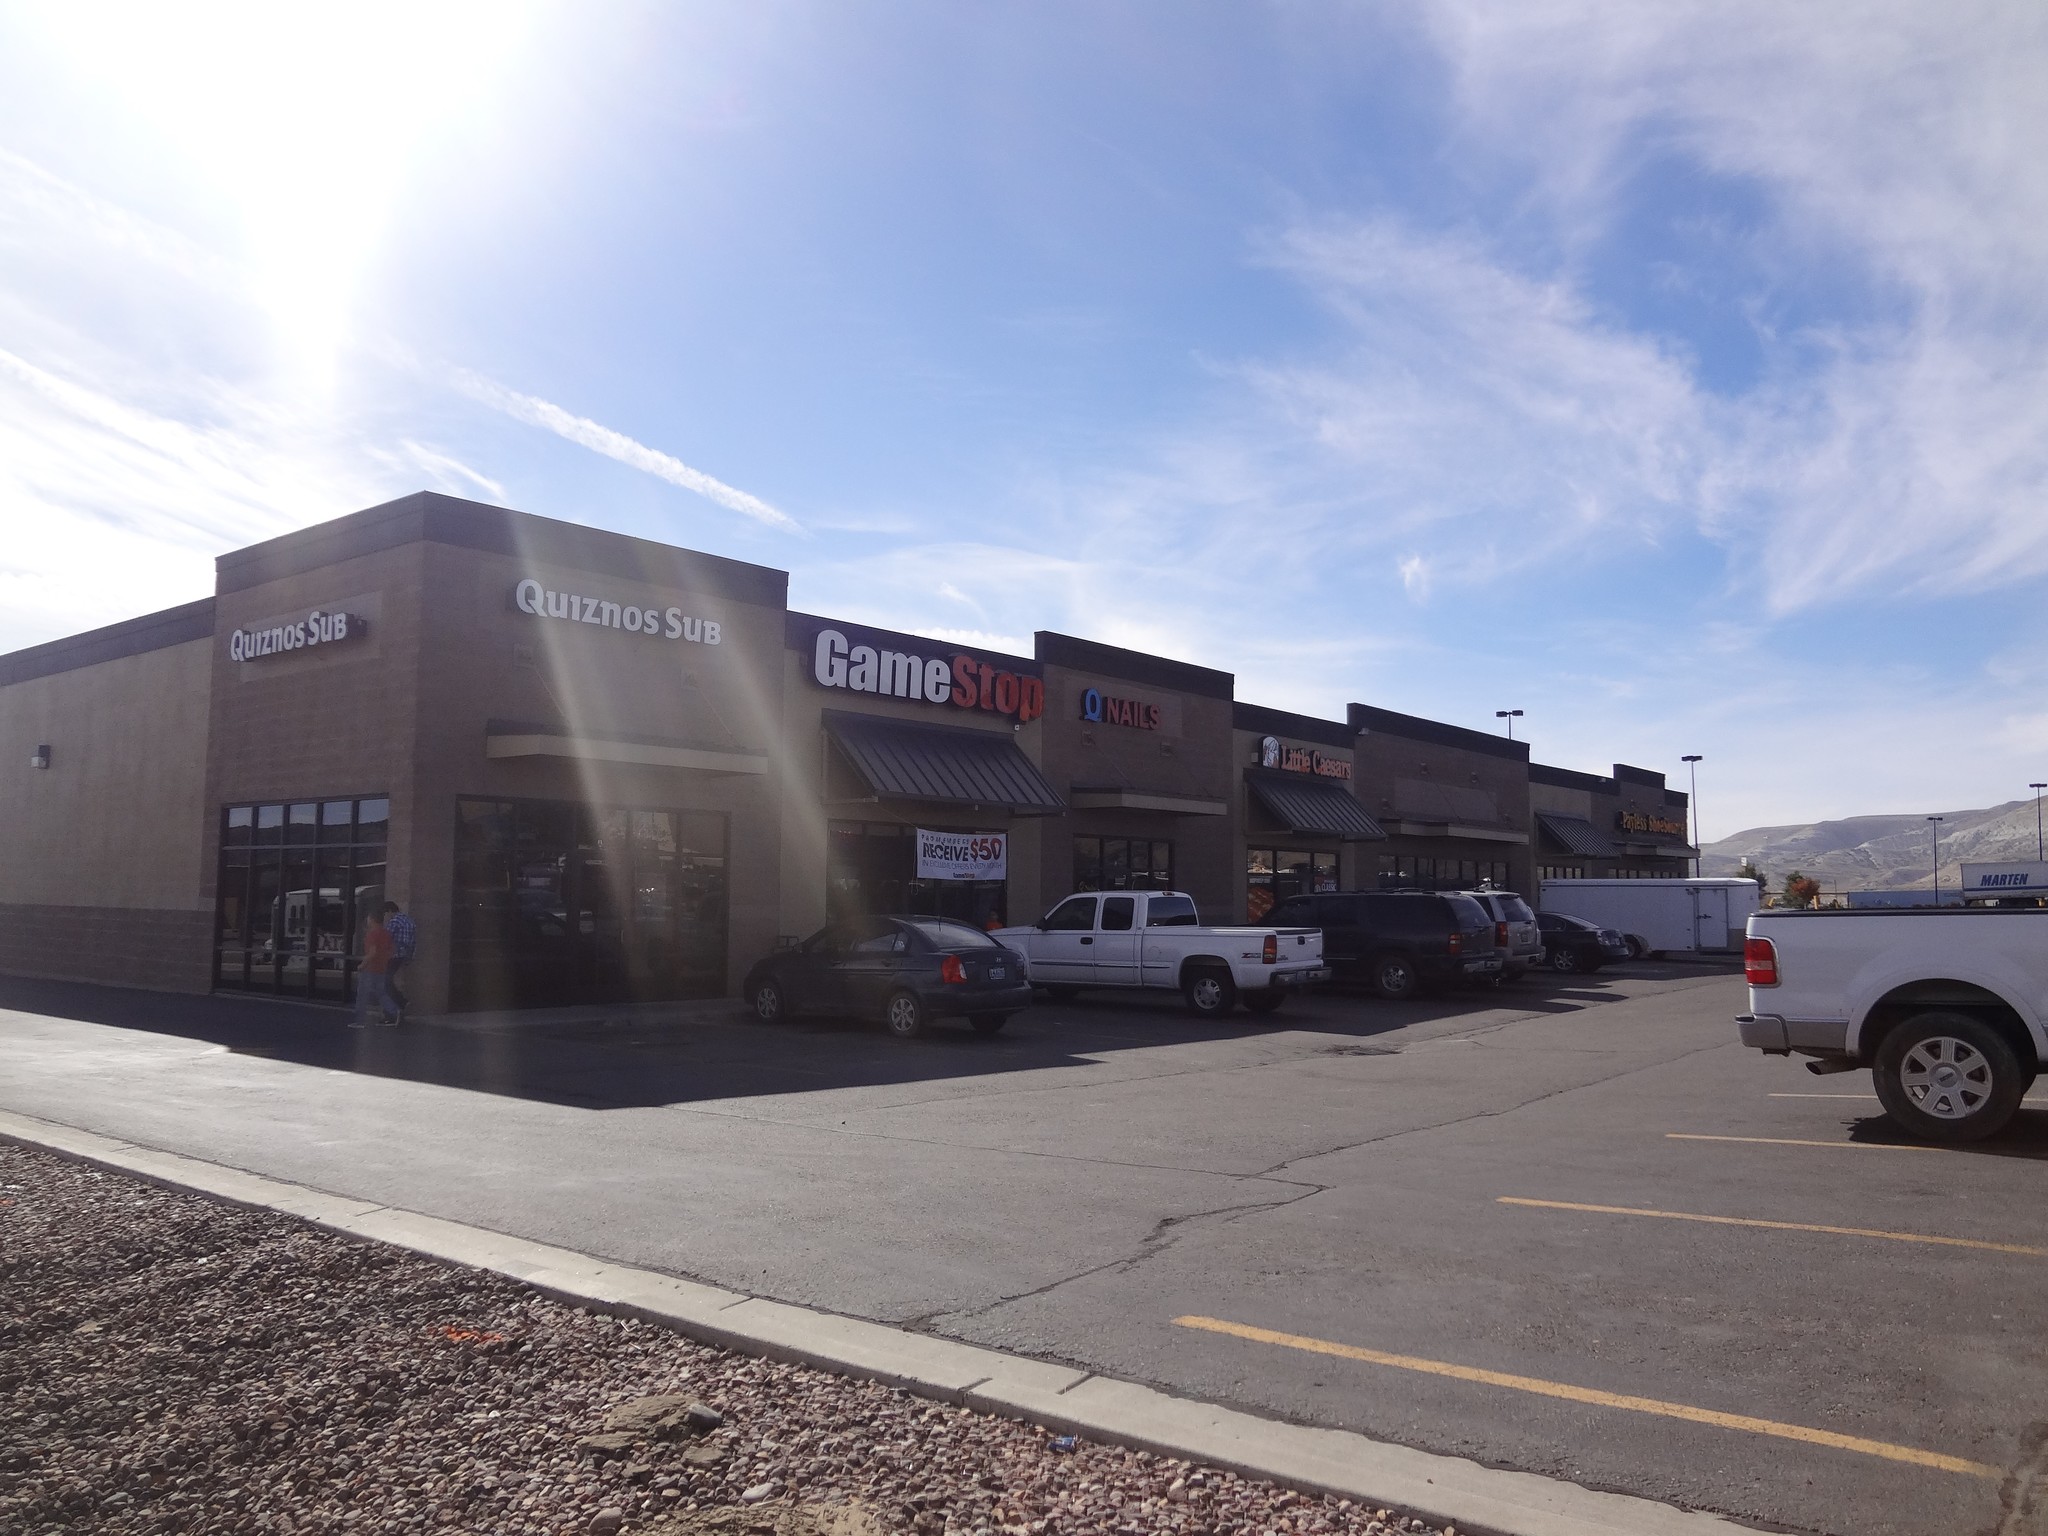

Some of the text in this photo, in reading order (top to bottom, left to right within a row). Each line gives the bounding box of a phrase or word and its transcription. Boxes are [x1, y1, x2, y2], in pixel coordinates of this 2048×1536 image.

[813, 629, 1045, 722] GameStop
[1083, 687, 1161, 731] Q NAILS
[1281, 745, 1351, 779] Little Caesars
[922, 838, 1002, 862] RECEIVE $50
[1980, 873, 2028, 886] MARTEN
